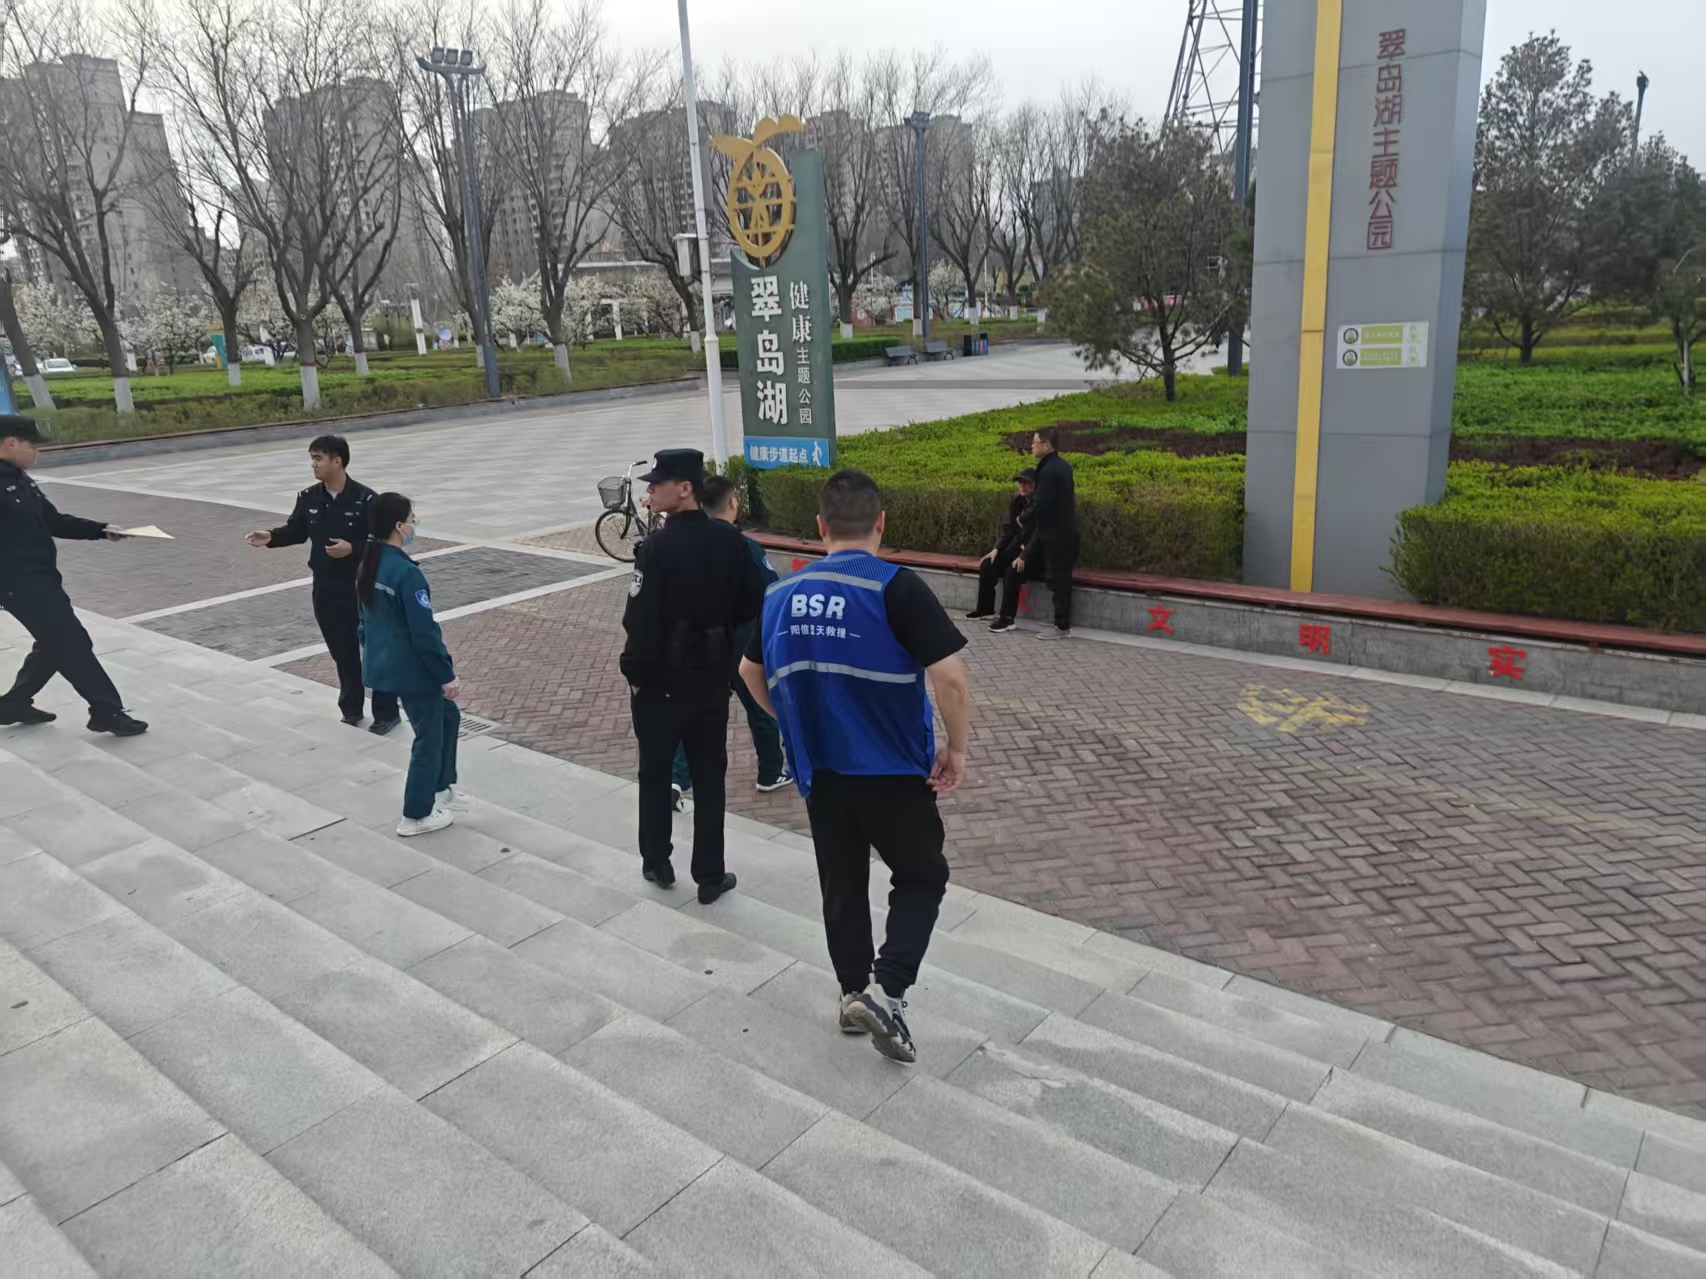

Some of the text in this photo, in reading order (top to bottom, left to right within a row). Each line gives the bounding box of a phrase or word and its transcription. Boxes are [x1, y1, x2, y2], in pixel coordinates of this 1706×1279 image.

[1366, 28, 1406, 251] 翠岛湖主题公园
[750, 275, 788, 425] 翠岛湖
[789, 280, 812, 425] 健康主题公园
[790, 593, 846, 620] BSR
[1147, 603, 1527, 680] 文 明 实
